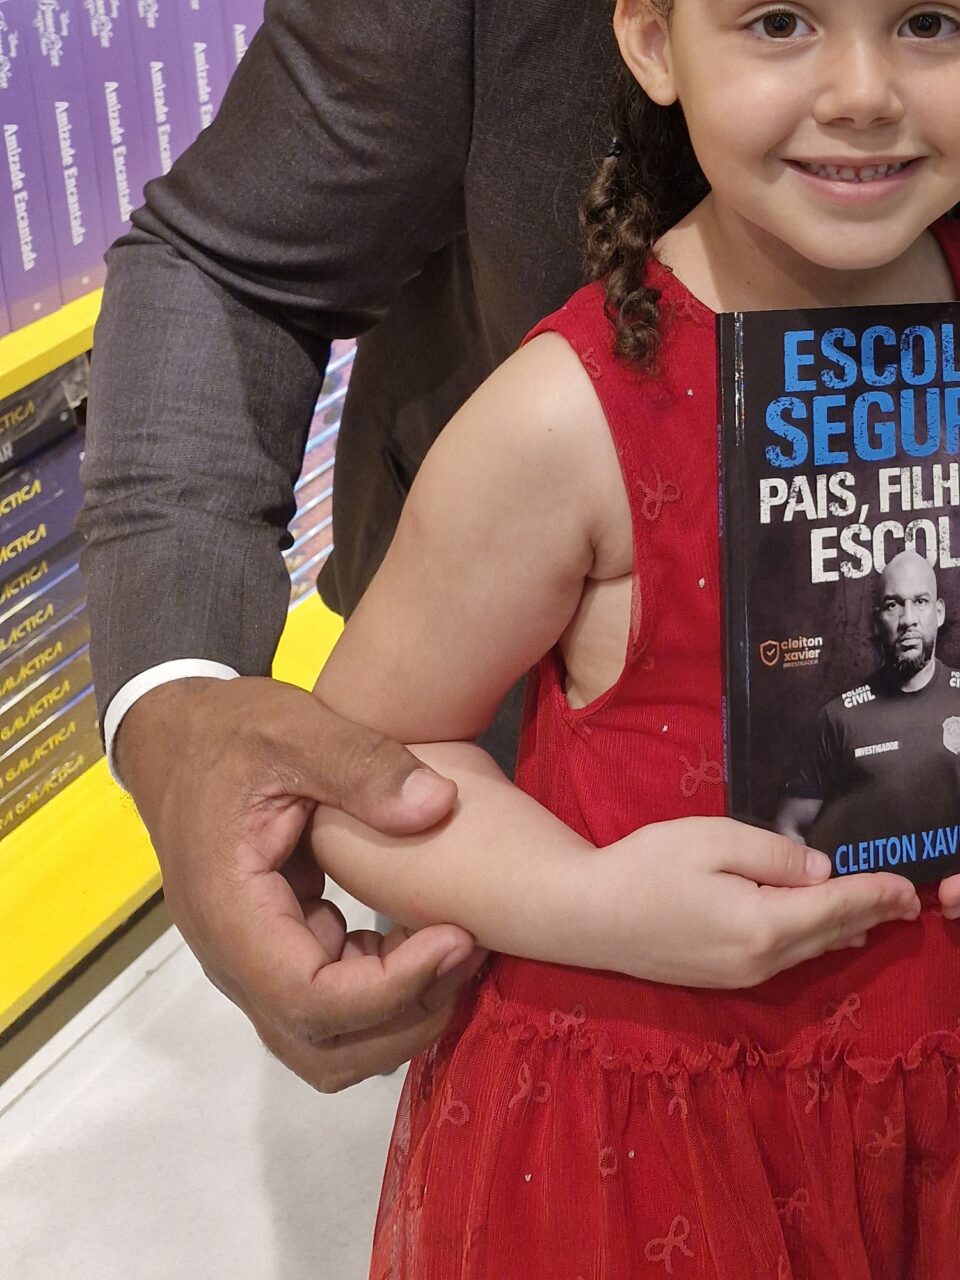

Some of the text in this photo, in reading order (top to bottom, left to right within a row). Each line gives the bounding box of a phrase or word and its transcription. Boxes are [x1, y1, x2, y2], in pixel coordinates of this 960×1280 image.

[0, 479, 42, 516] CTICA
[759, 471, 870, 524] PAIS,
[0, 523, 47, 566] ACTICA
[0, 560, 48, 604] ACTICA
[781, 636, 823, 649] cleiton
[784, 648, 821, 662] xavier
[844, 690, 876, 708] CIVIL
[854, 740, 899, 758] INVESTIGADOR
[835, 833, 917, 875] CLEITON
